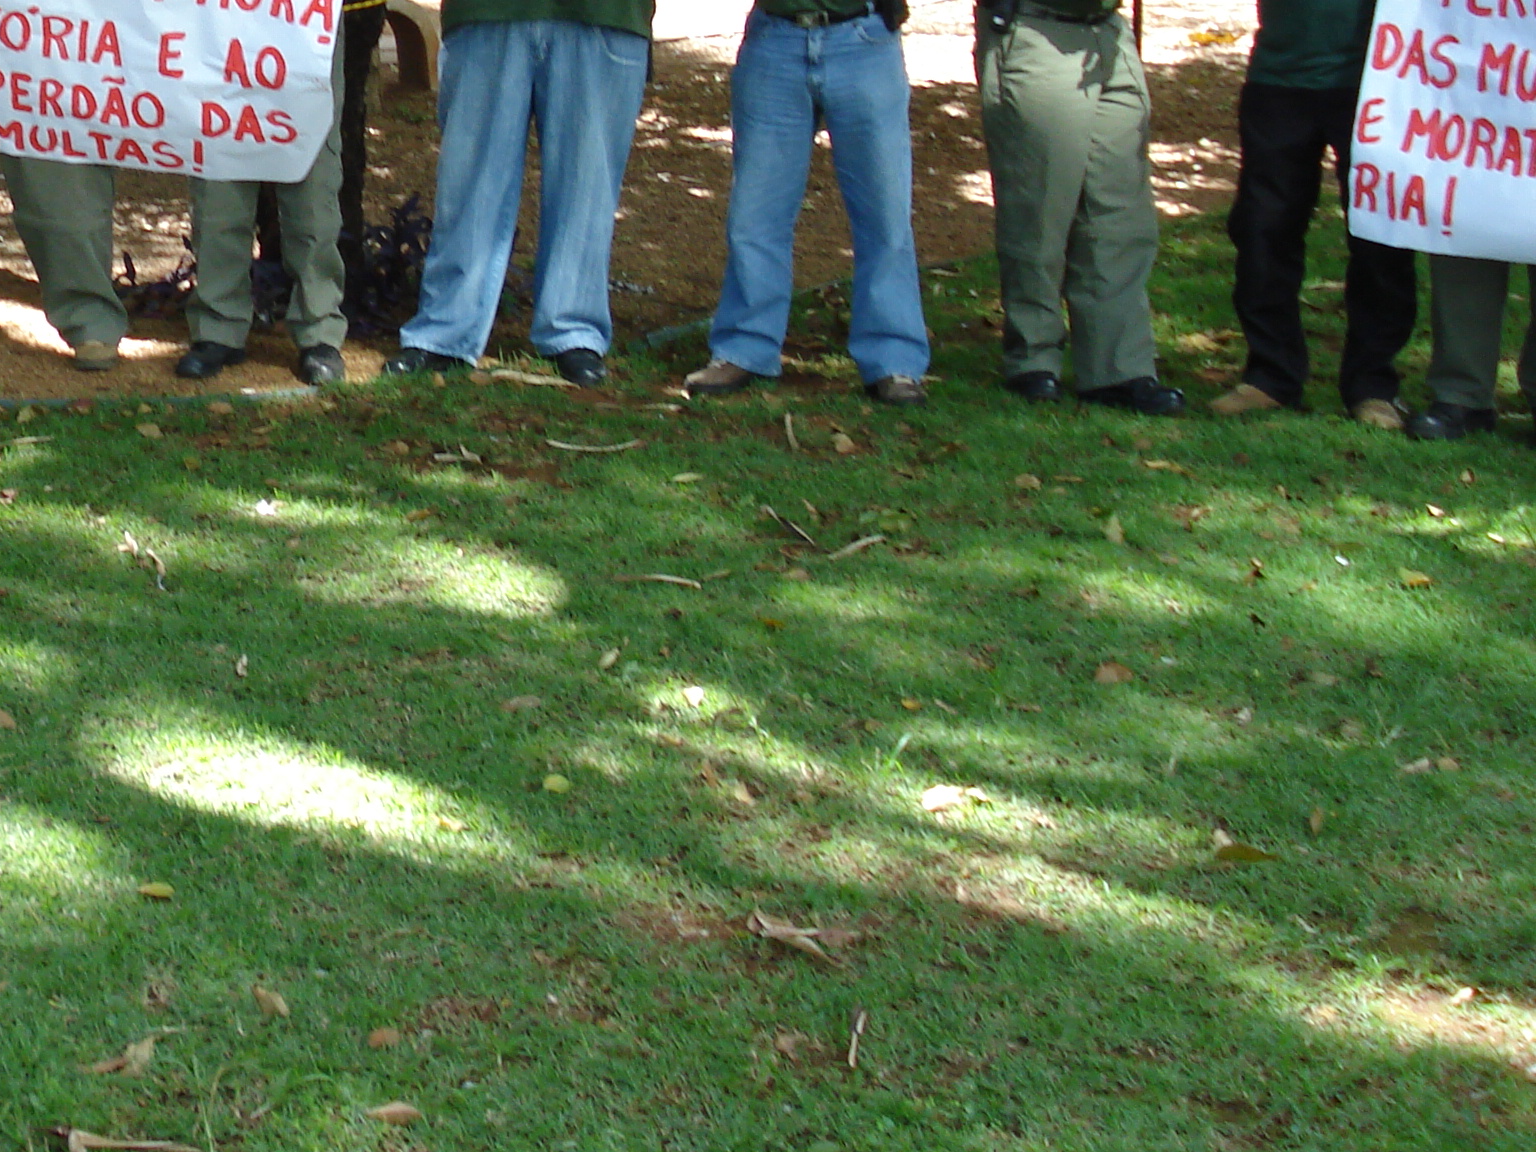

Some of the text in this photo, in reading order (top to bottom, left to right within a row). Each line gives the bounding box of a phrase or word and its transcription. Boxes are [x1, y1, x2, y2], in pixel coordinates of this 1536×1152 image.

[158, 32, 186, 78] E
[224, 38, 287, 90] AO
[1372, 22, 1461, 90] DAS
[202, 101, 299, 144] DAS
[1356, 98, 1386, 145] E
